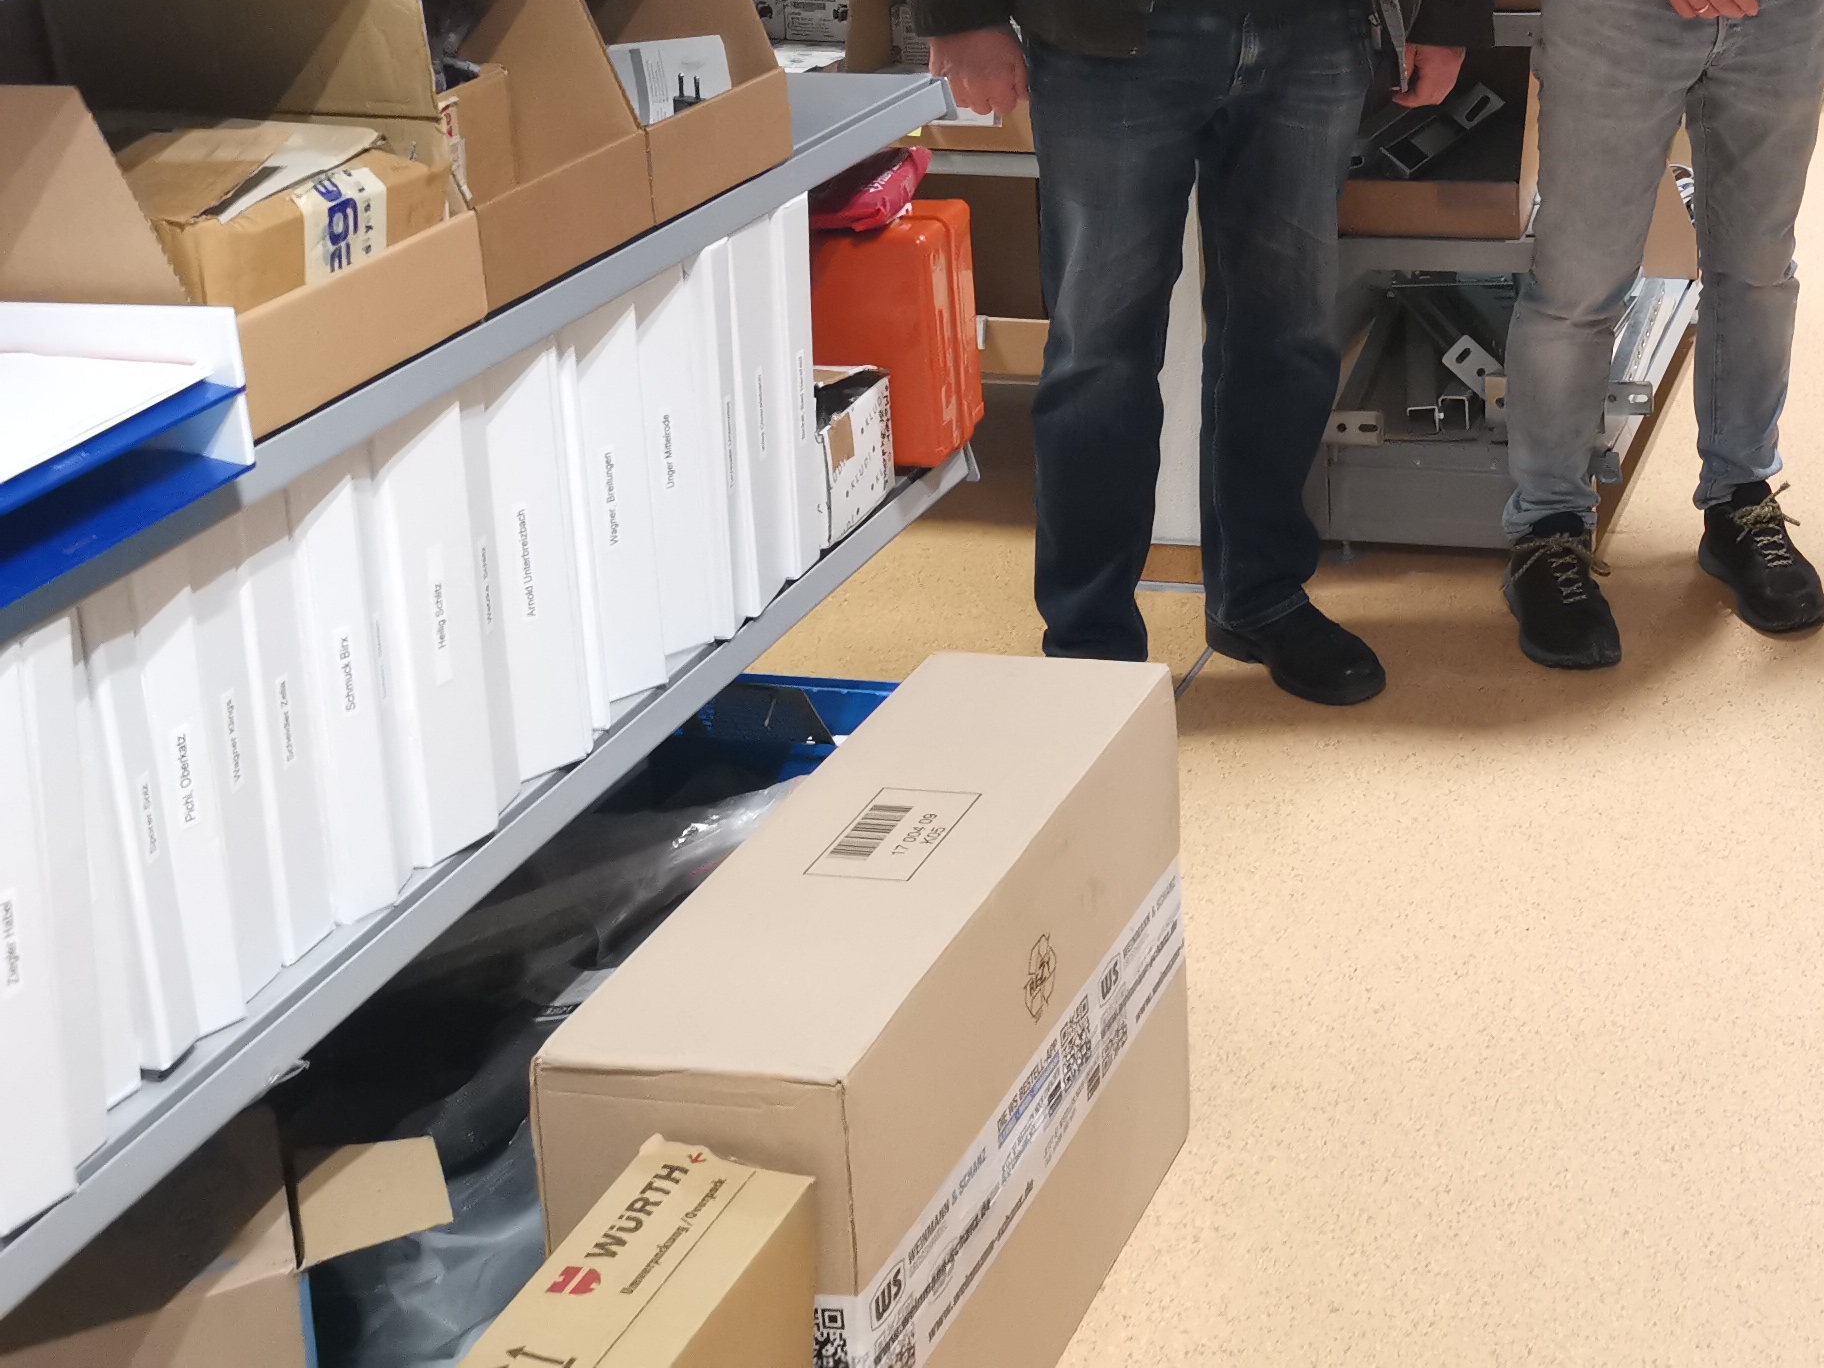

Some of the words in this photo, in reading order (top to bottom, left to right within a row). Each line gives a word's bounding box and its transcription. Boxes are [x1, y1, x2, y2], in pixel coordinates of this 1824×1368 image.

[605, 451, 617, 501] Breitungen
[666, 462, 676, 490] Unger
[517, 508, 533, 579] Unterbreizbach
[525, 583, 537, 618] Arnold
[438, 618, 447, 650] Heilig
[343, 663, 357, 713] Schmuck
[176, 732, 194, 790] Oberkatz
[892, 844, 910, 856] 17
[903, 826, 926, 844] 004
[919, 813, 938, 825] 09
[919, 826, 947, 845] K05
[1100, 958, 1121, 1001] WS
[1018, 1037, 1058, 1102] BESTELL-APP
[584, 1162, 691, 1260] WÜRTH
[907, 1198, 950, 1265] WEINMANN
[959, 1145, 988, 1197] SCHANZ
[874, 1266, 902, 1322] WS
